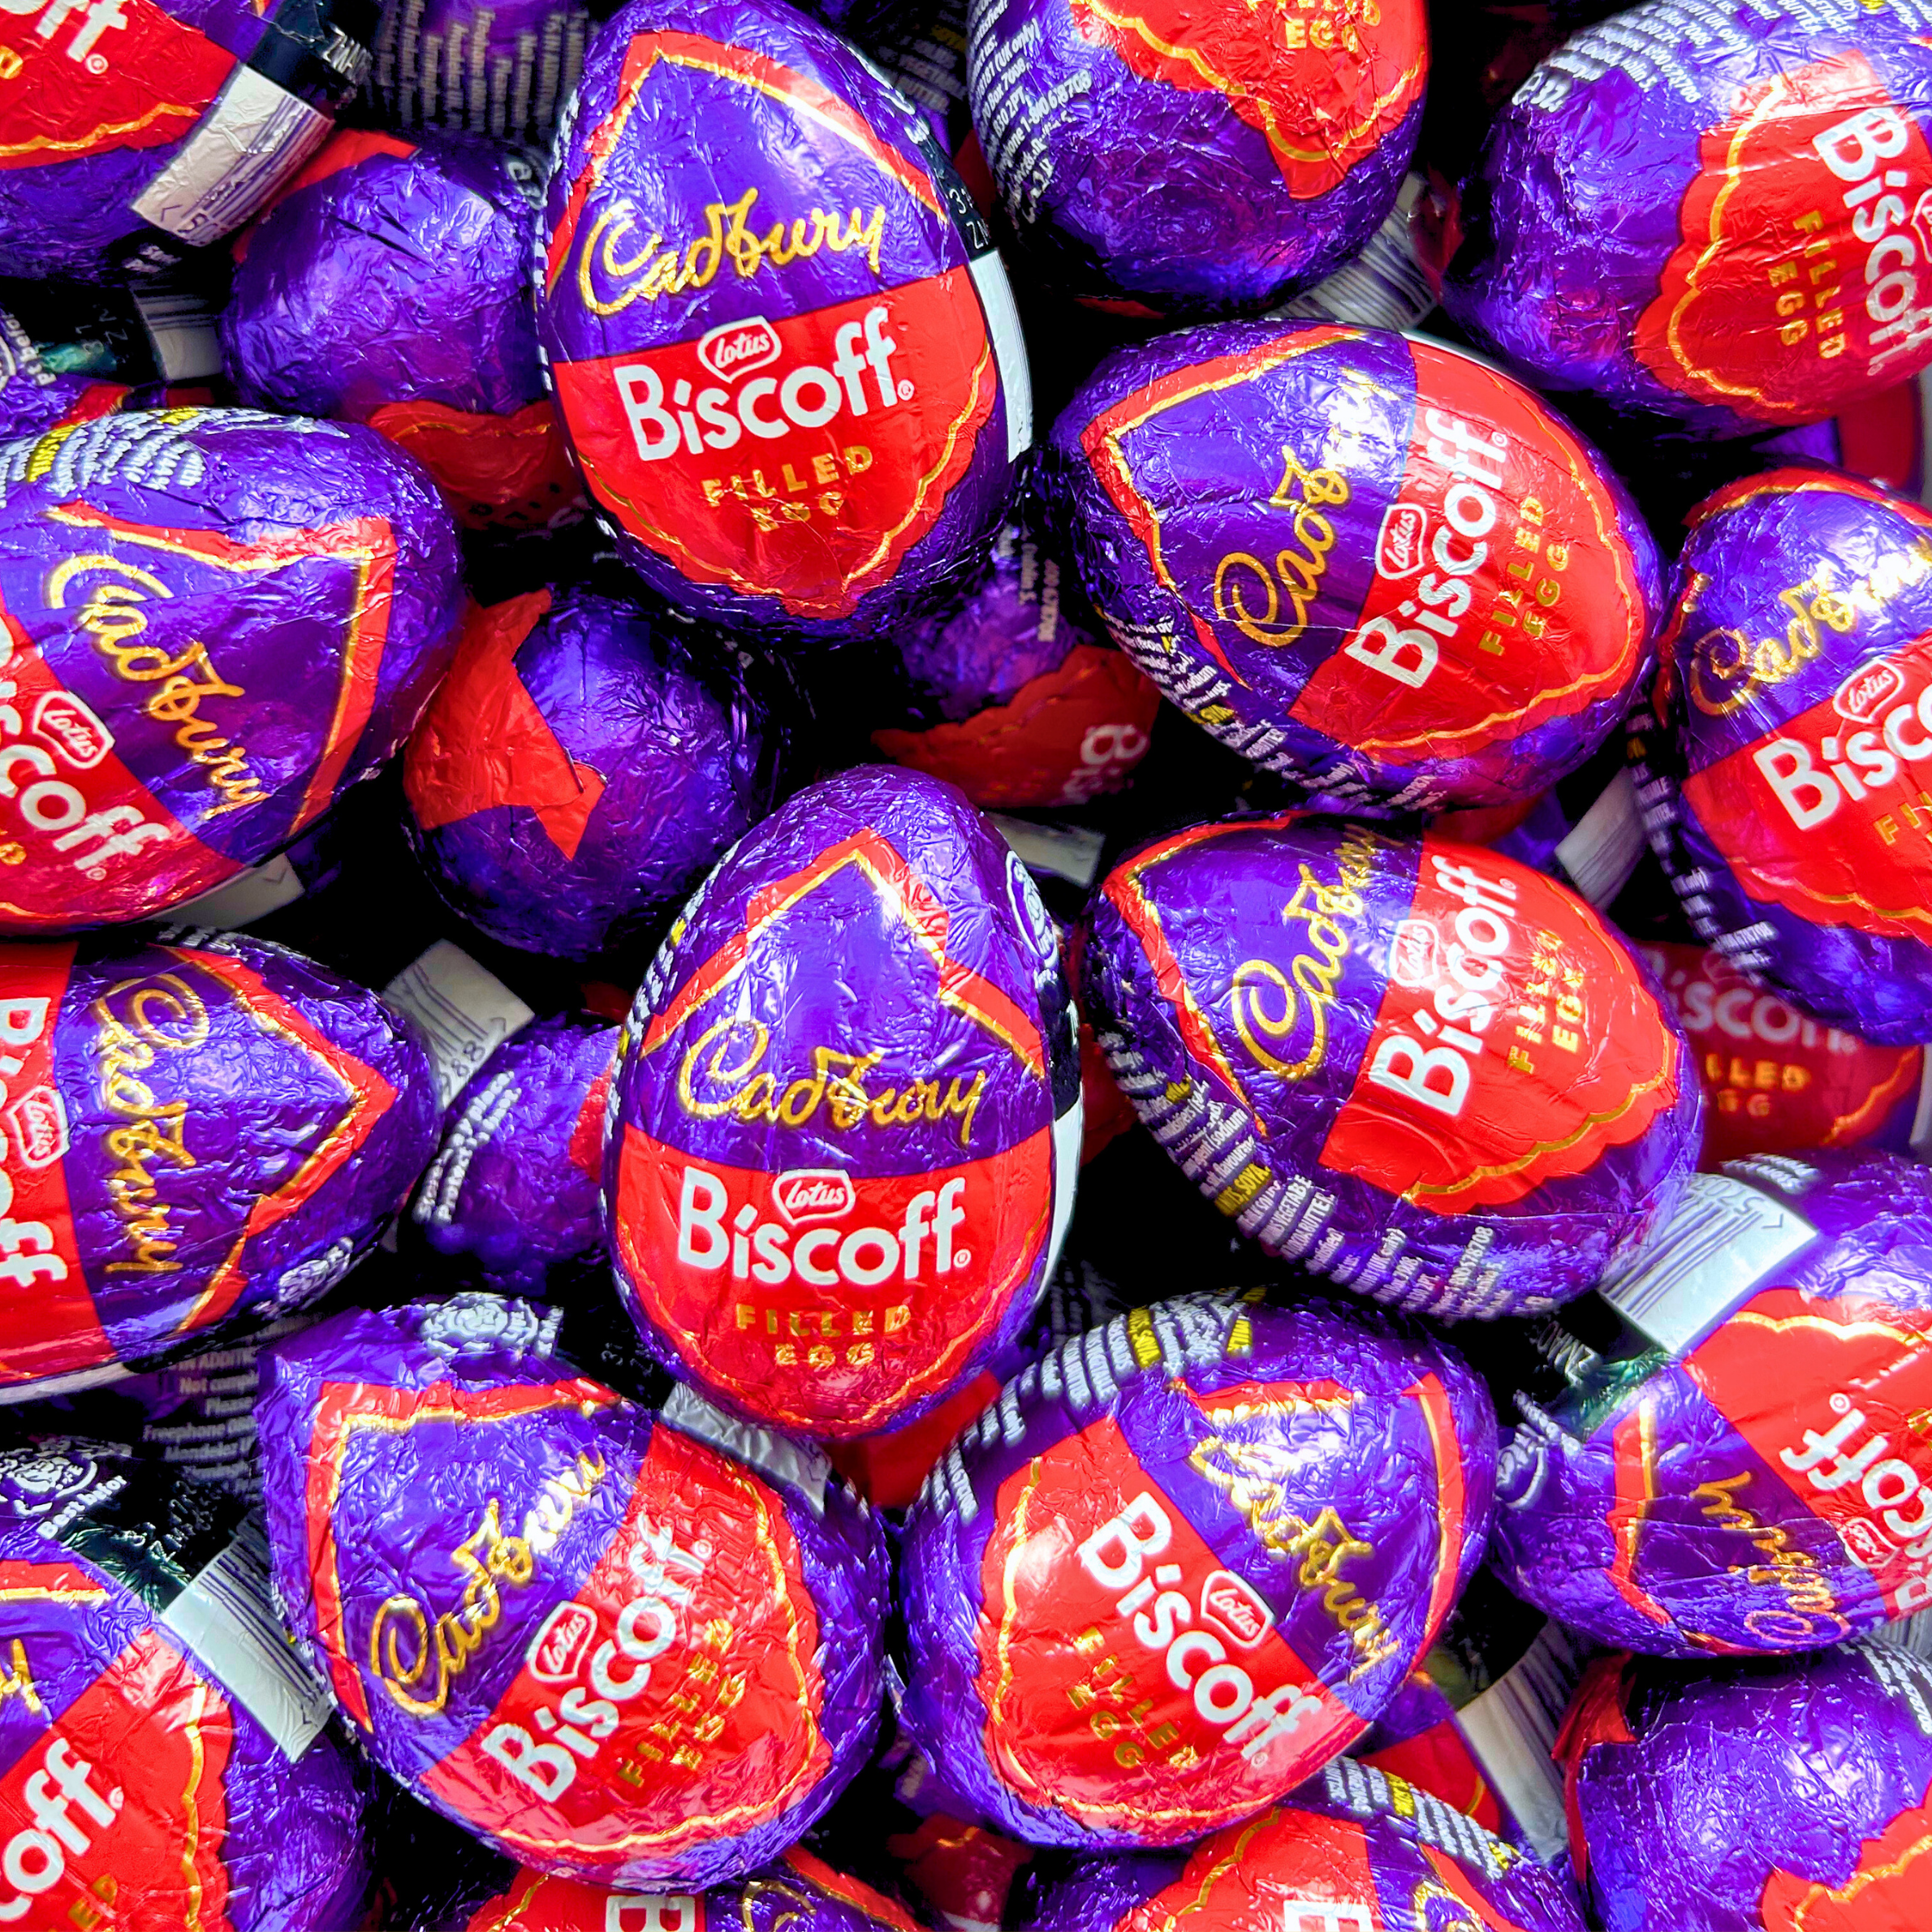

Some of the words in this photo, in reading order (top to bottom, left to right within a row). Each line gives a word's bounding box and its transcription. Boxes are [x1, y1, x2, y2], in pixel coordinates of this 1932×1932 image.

[579, 188, 885, 315] Cadbury
[1793, 210, 1845, 359] FILLED
[614, 306, 895, 462] Biscoff
[701, 445, 873, 507] FILLED
[1344, 408, 1507, 688] Biscoff
[1480, 494, 1544, 657] FILLED
[1520, 542, 1568, 637] EGG
[46, 554, 271, 822] Cadbury
[1367, 855, 1518, 1116] Biscoff
[91, 973, 209, 1274] Cadbury
[676, 1017, 985, 1144] Cadbury
[678, 1167, 966, 1287] Biscoff
[787, 1180, 846, 1210] Lotus
[736, 1303, 912, 1338] FILLED
[481, 1512, 705, 1802] Biscoff
[1077, 1491, 1323, 1761] Biscoff
